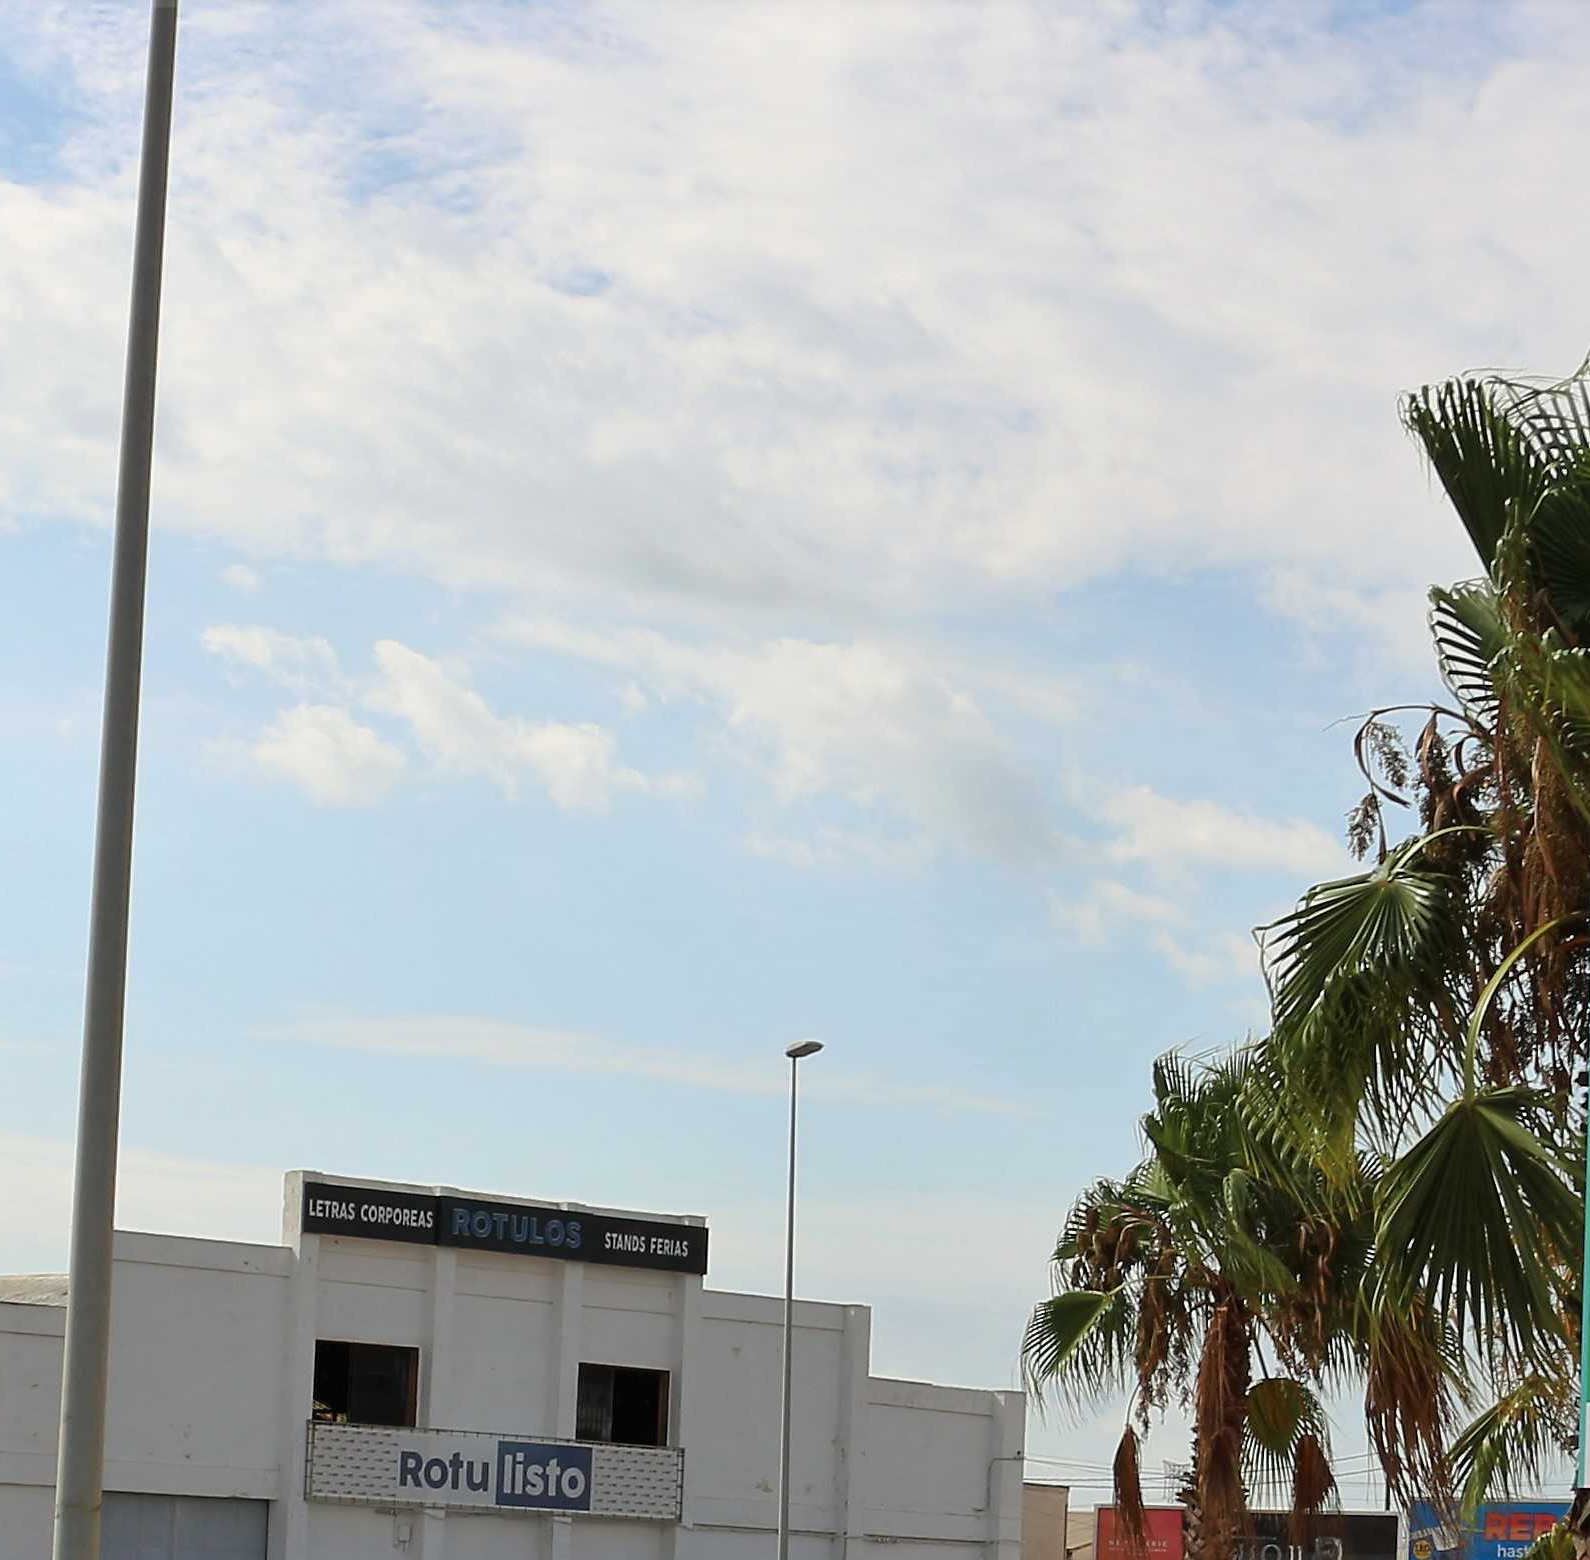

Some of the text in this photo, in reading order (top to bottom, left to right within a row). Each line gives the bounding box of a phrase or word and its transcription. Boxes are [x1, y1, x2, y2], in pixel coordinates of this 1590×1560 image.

[308, 1198, 434, 1230] LETRAS CORPOREAS
[451, 1207, 582, 1249] ROTULOS
[604, 1231, 689, 1259] STANDS FERIAS
